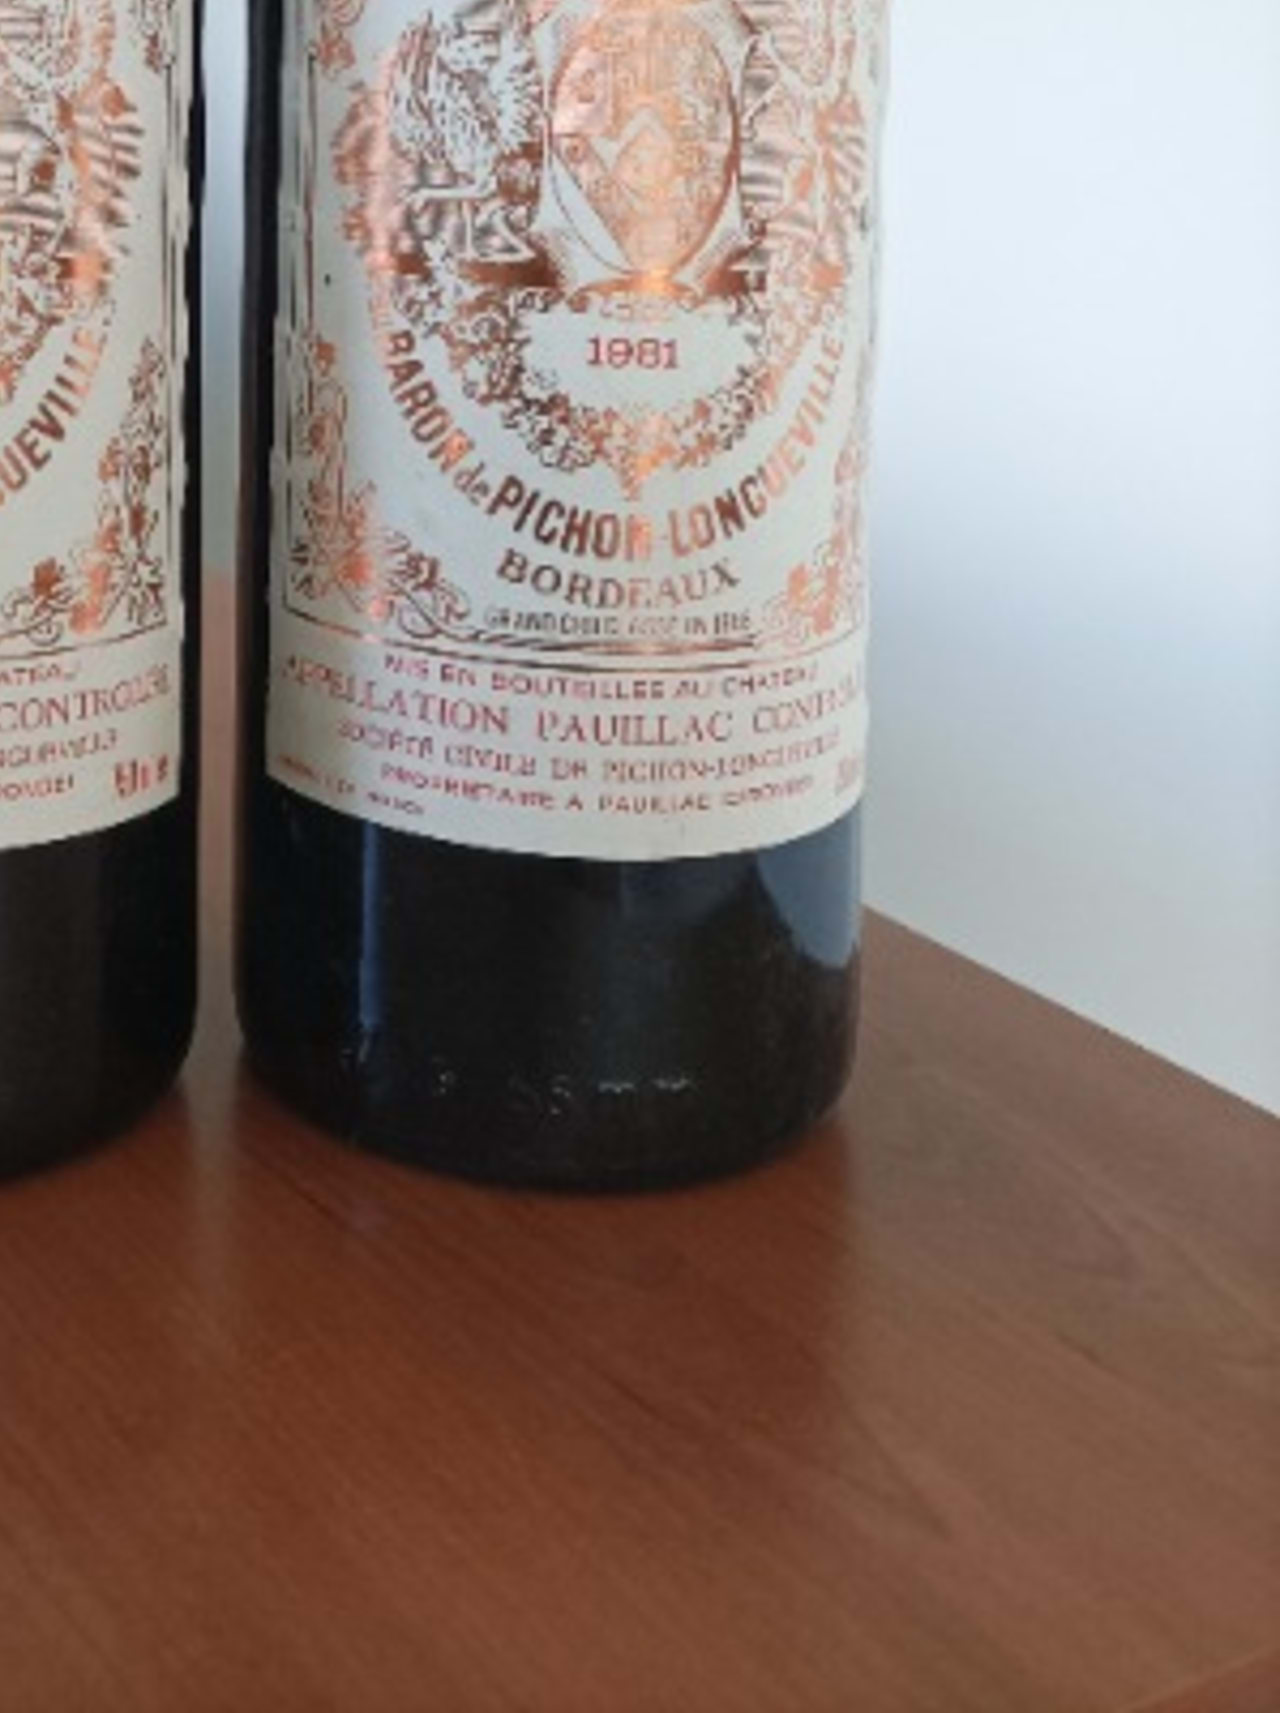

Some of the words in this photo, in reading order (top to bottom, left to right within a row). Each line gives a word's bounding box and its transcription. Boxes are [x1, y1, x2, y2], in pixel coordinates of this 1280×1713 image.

[586, 336, 680, 371] 1981
[453, 461, 491, 507] de
[495, 546, 740, 609] BORDEAUX
[440, 664, 477, 687] EN
[491, 672, 665, 699] BOUTEILLES
[537, 711, 733, 746] PAUILLAC
